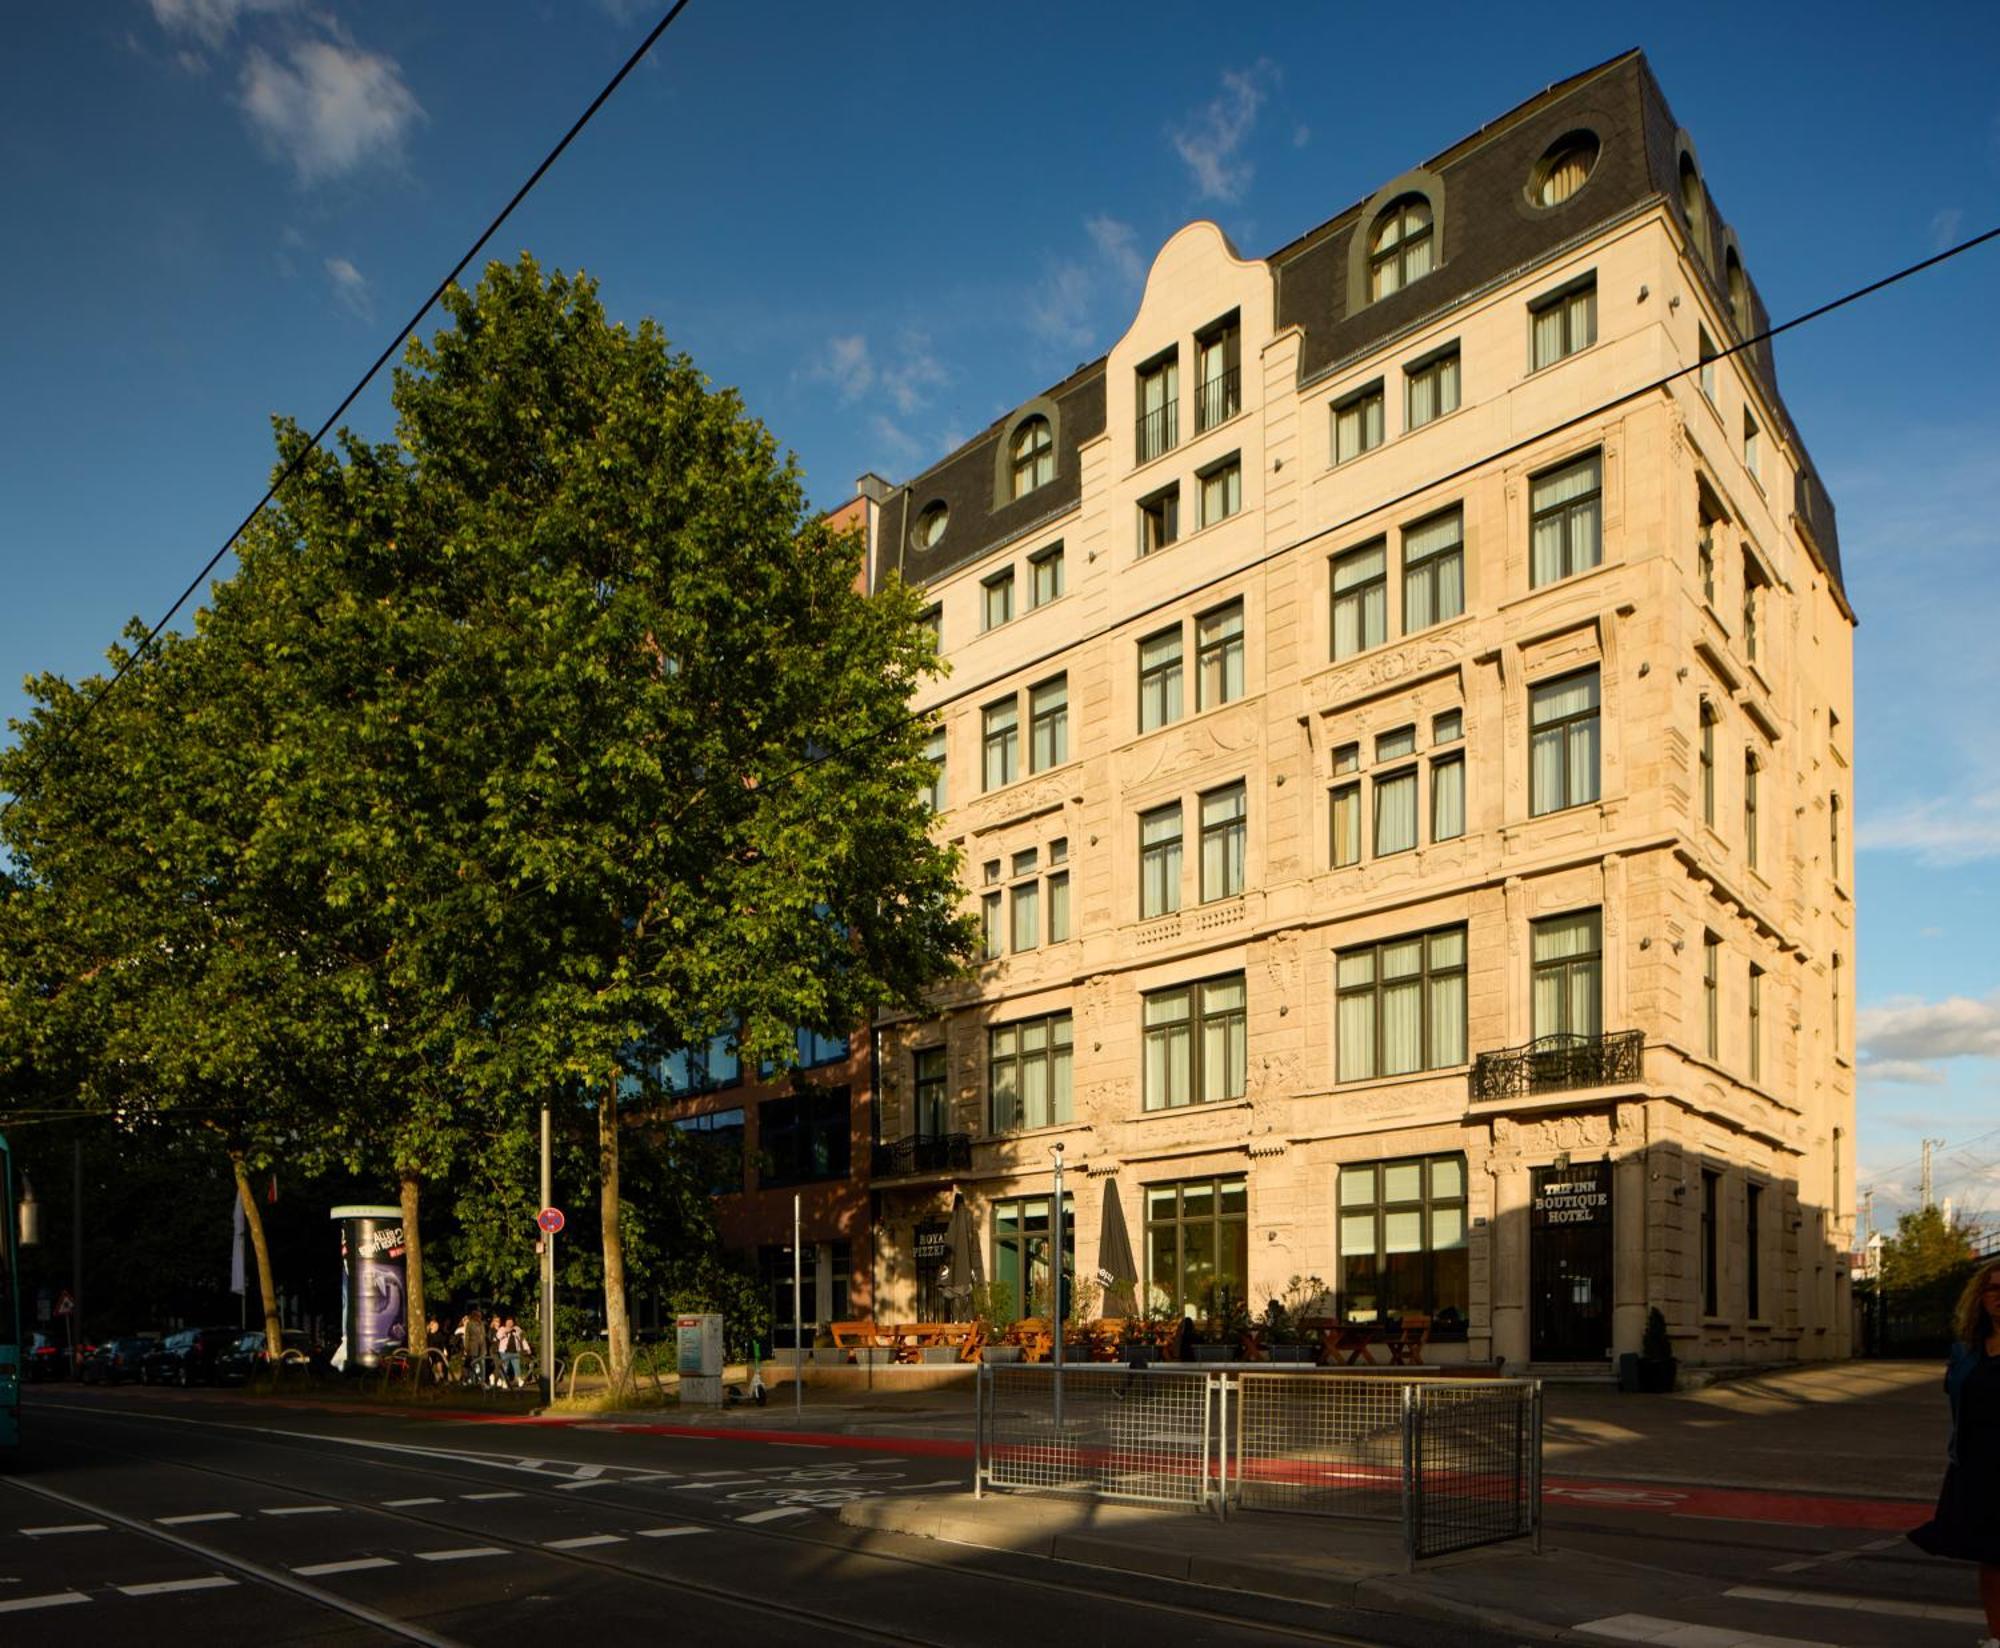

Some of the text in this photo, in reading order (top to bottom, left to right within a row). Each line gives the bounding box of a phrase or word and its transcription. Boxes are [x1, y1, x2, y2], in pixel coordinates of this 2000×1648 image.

[1543, 1180, 1596, 1195] TRIP INN
[1535, 1192, 1607, 1211] BOUTIQUE
[1548, 1209, 1594, 1223] HOTEL
